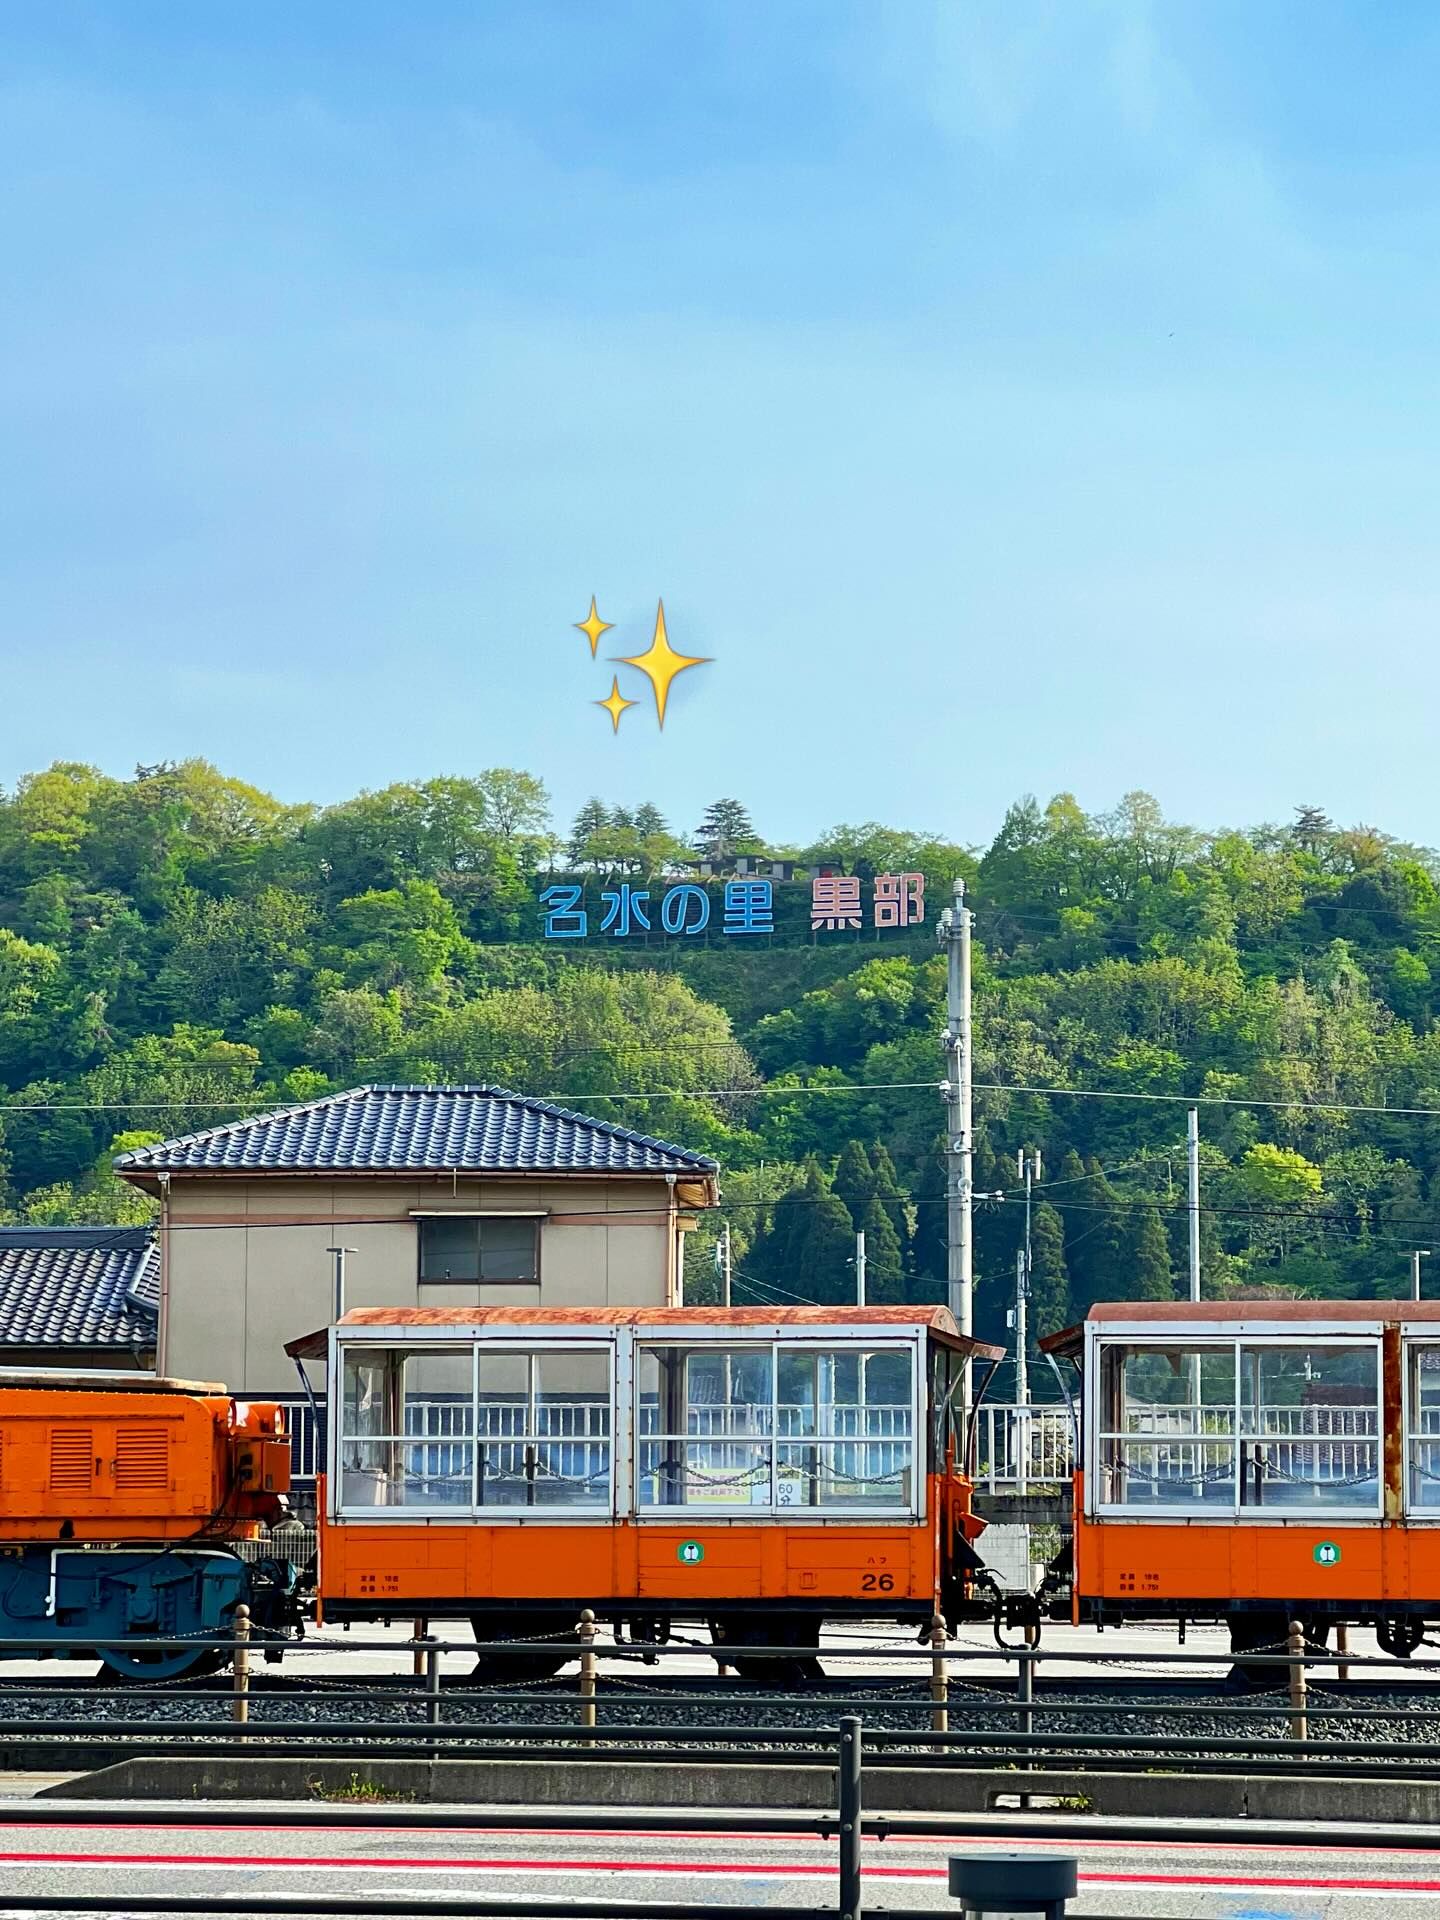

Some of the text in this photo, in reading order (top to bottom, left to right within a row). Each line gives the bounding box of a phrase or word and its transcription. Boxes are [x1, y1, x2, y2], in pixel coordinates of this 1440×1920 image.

[539, 872, 925, 938] 名水の里 黒部
[778, 1483, 793, 1494] 60
[862, 1573, 894, 1591] 26
